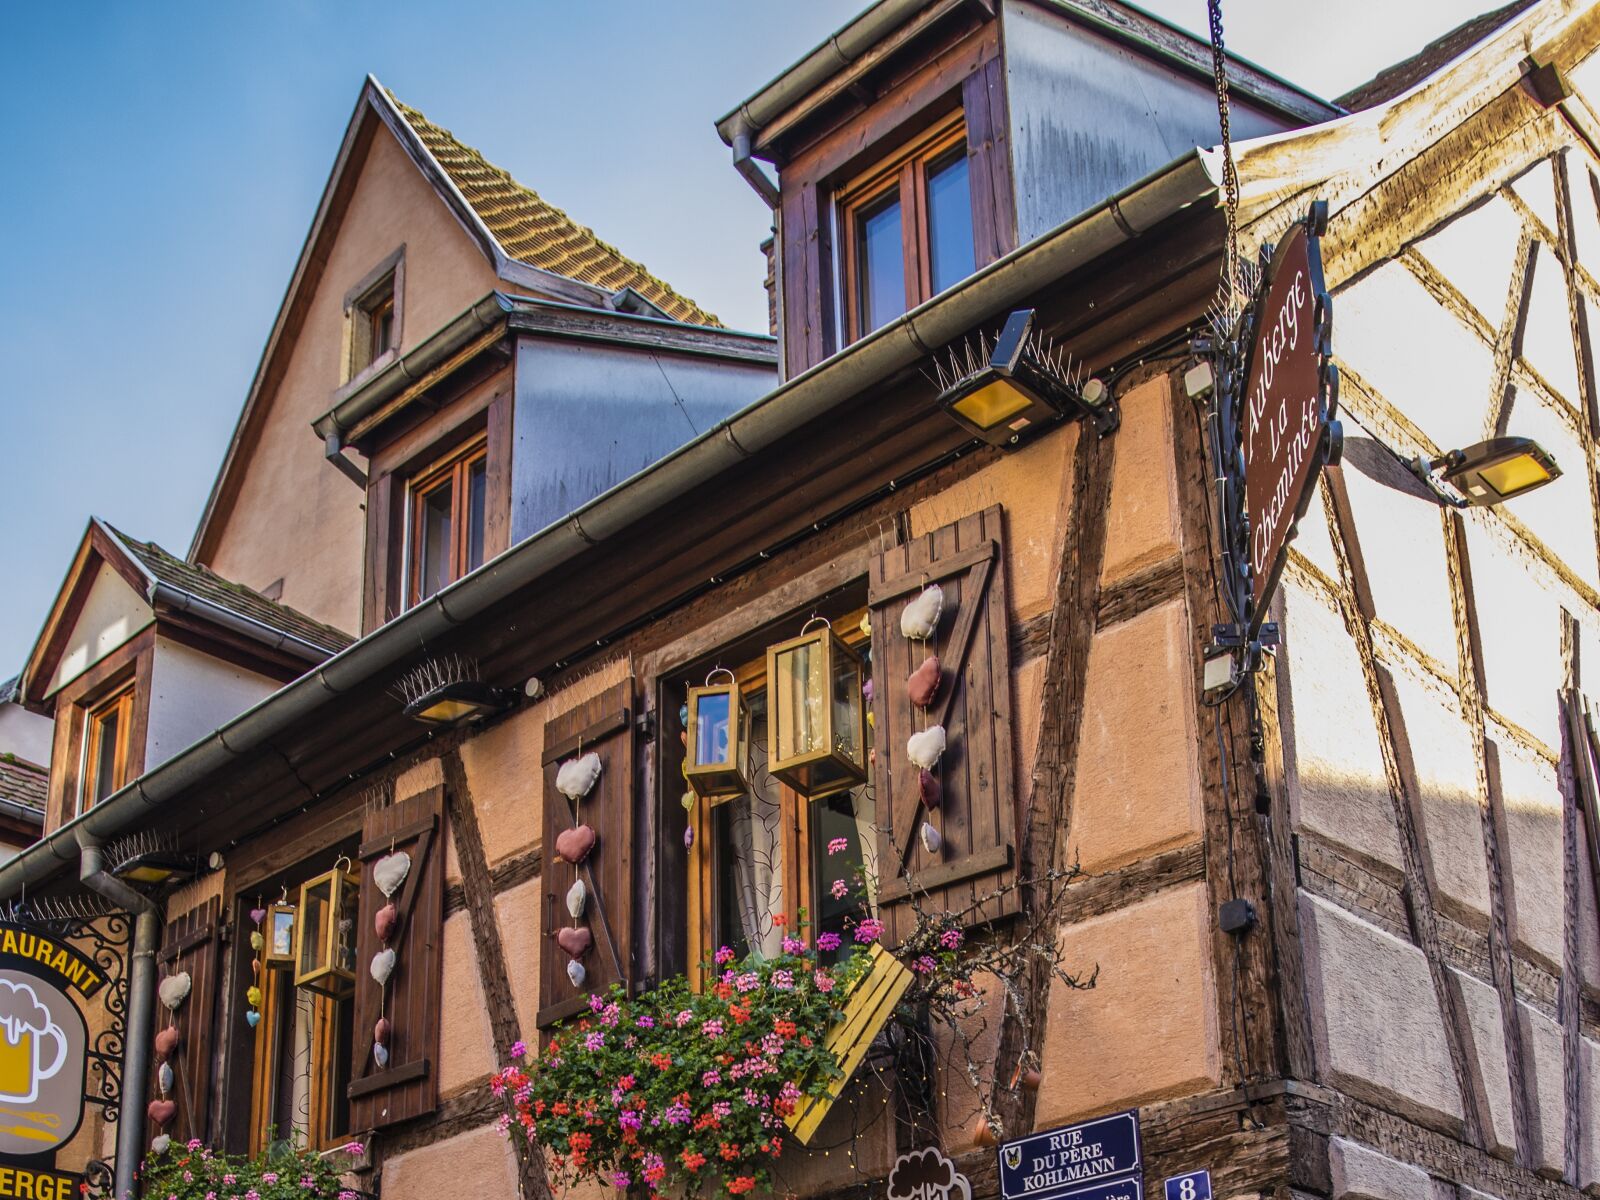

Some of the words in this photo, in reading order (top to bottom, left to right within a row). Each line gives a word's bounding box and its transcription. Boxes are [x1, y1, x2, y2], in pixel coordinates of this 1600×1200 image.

[1249, 270, 1305, 465] Auberge
[1269, 398, 1288, 463] La
[0, 928, 100, 991] AURANT
[1032, 1153, 1056, 1173] DU
[1060, 1142, 1103, 1167] PÈRE
[1050, 1130, 1082, 1151] RUE
[1023, 1156, 1116, 1192] KOHLMANN
